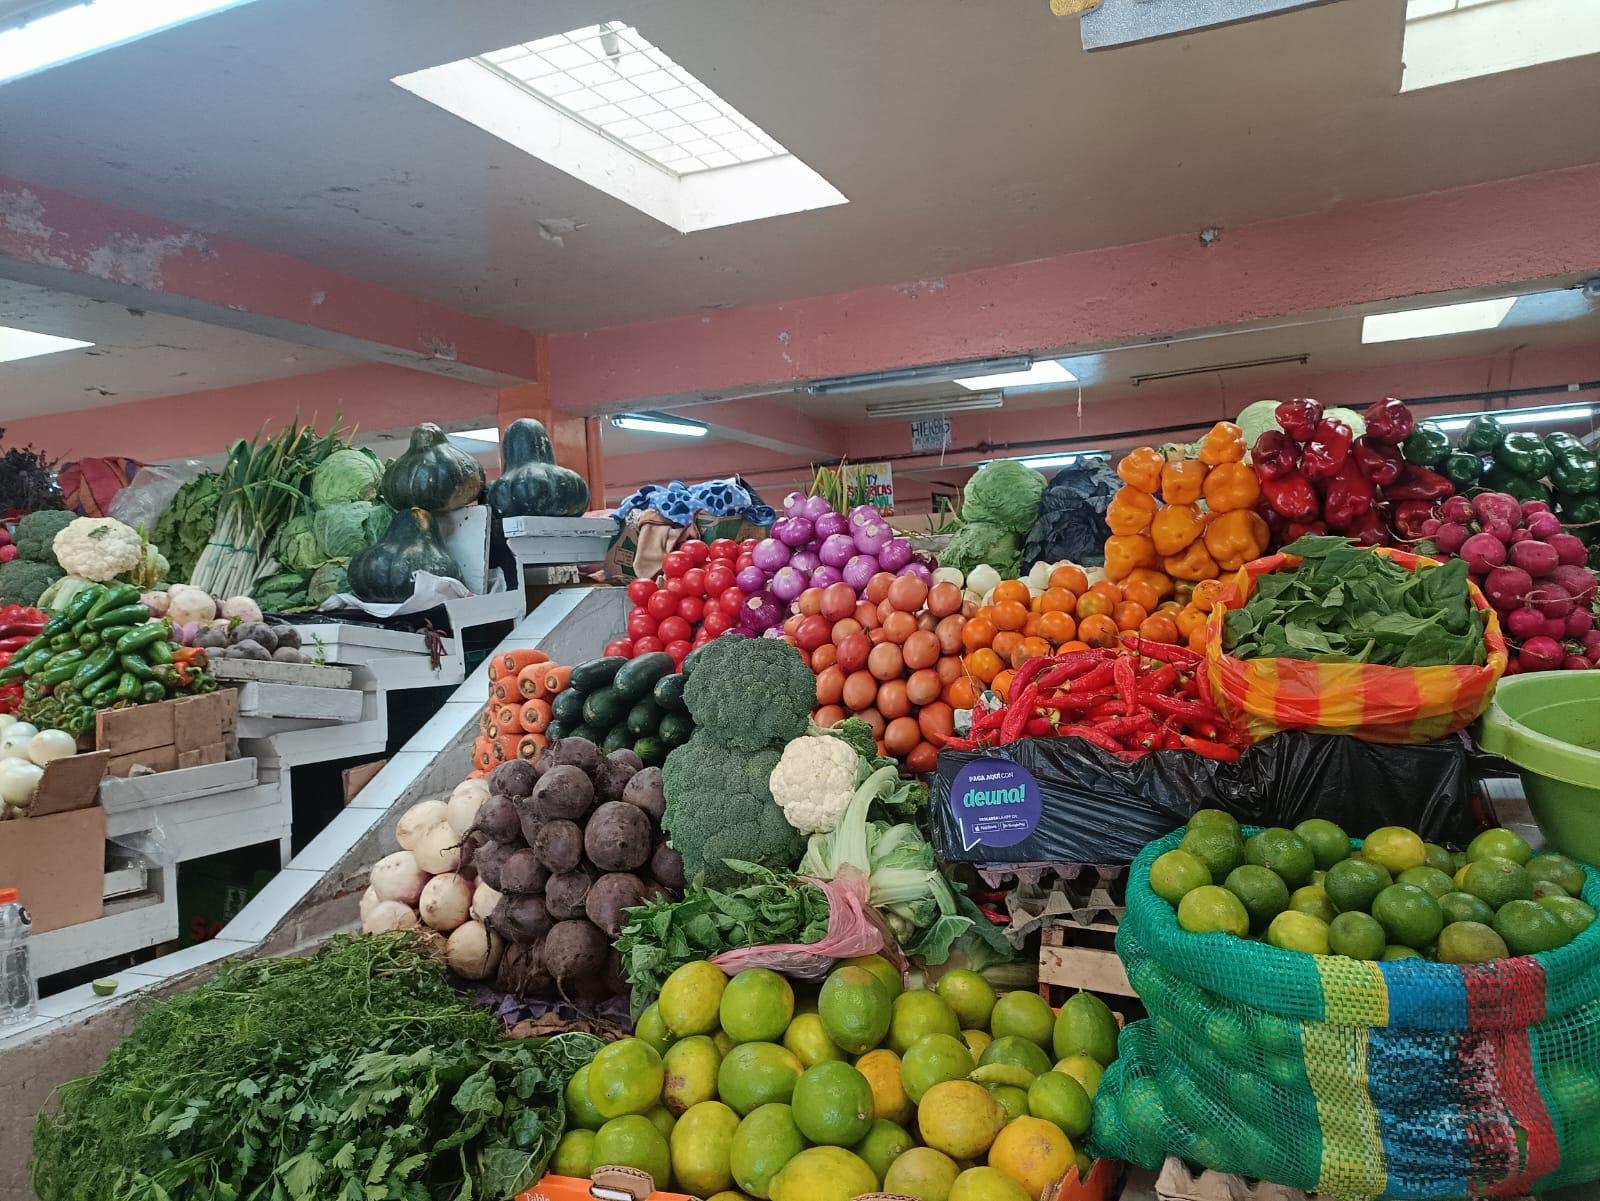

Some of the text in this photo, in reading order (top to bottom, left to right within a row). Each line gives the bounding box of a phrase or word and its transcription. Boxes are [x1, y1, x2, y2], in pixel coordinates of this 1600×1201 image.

[911, 417, 950, 438] HIERBAS
[1001, 771, 1014, 779] CON
[963, 784, 1025, 807] deuna!
